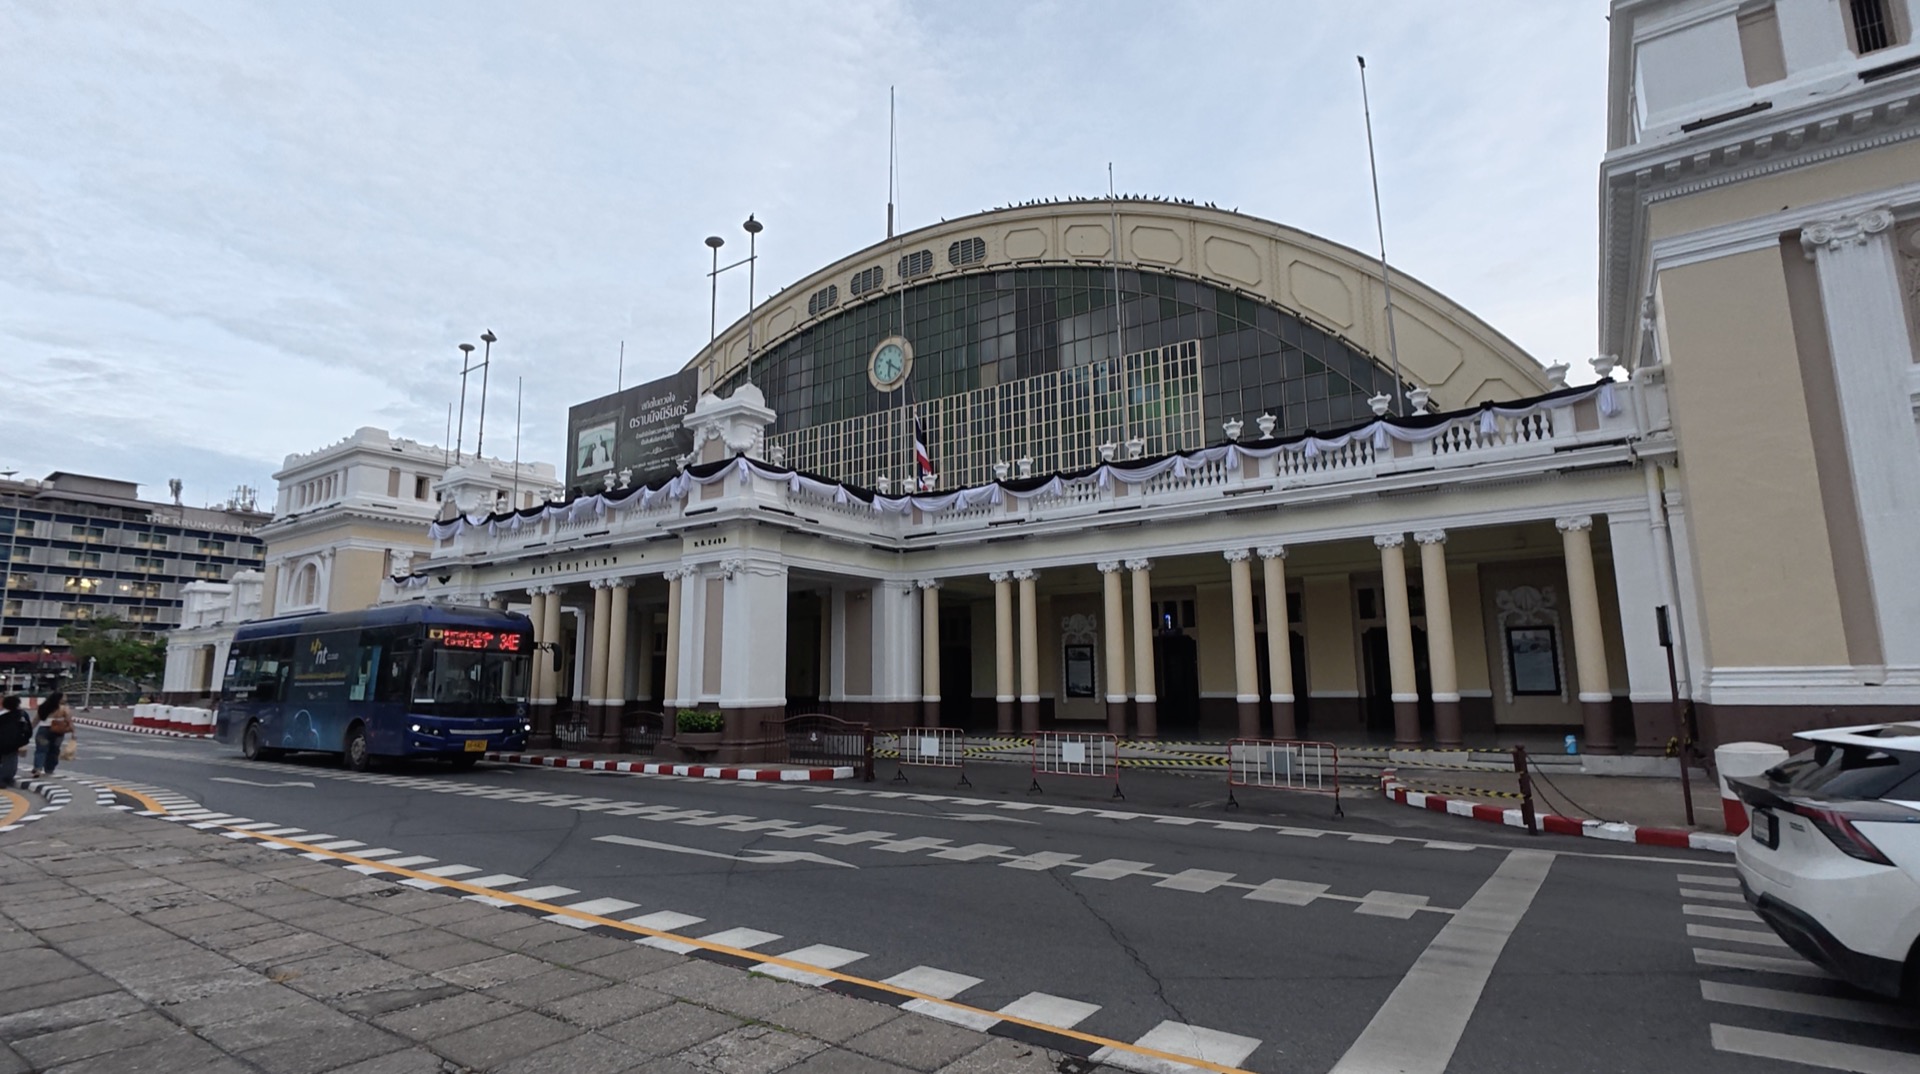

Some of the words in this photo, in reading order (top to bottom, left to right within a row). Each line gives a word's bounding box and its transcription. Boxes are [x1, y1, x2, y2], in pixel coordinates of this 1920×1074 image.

[629, 395, 692, 429] ตราบนิจนิรันดร์
[145, 513, 170, 525] THE
[172, 519, 253, 535] KRUNGKASEM
[532, 556, 618, 575] สถานีกรุงเทพ
[499, 633, 521, 651] 34E
[315, 646, 328, 665] nt
